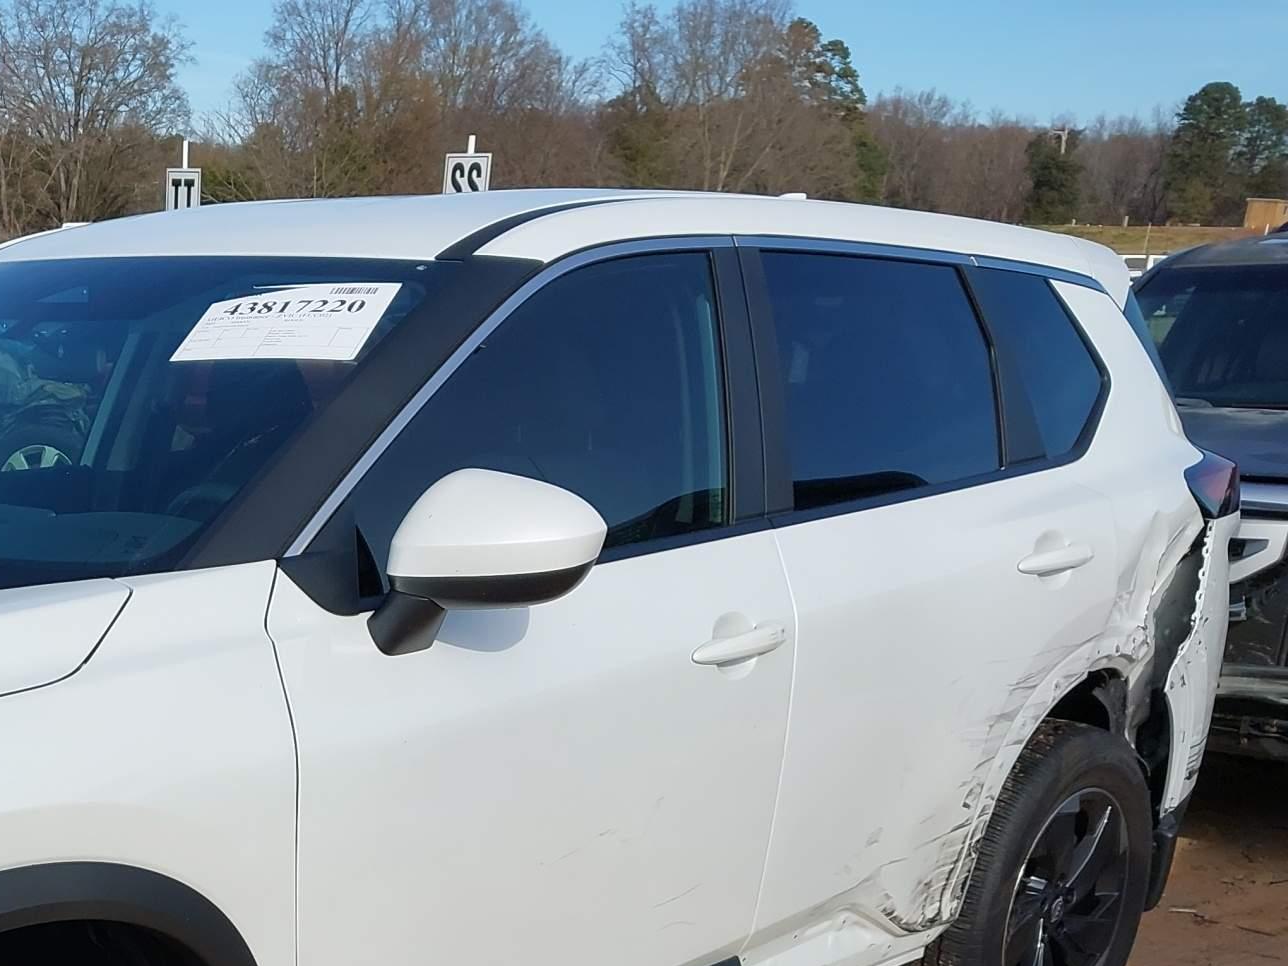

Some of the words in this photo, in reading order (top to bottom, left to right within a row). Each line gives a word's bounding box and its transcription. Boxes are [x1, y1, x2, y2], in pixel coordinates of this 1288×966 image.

[451, 162, 482, 193] SS
[172, 178, 195, 209] TT
[223, 299, 367, 316] 43817220
